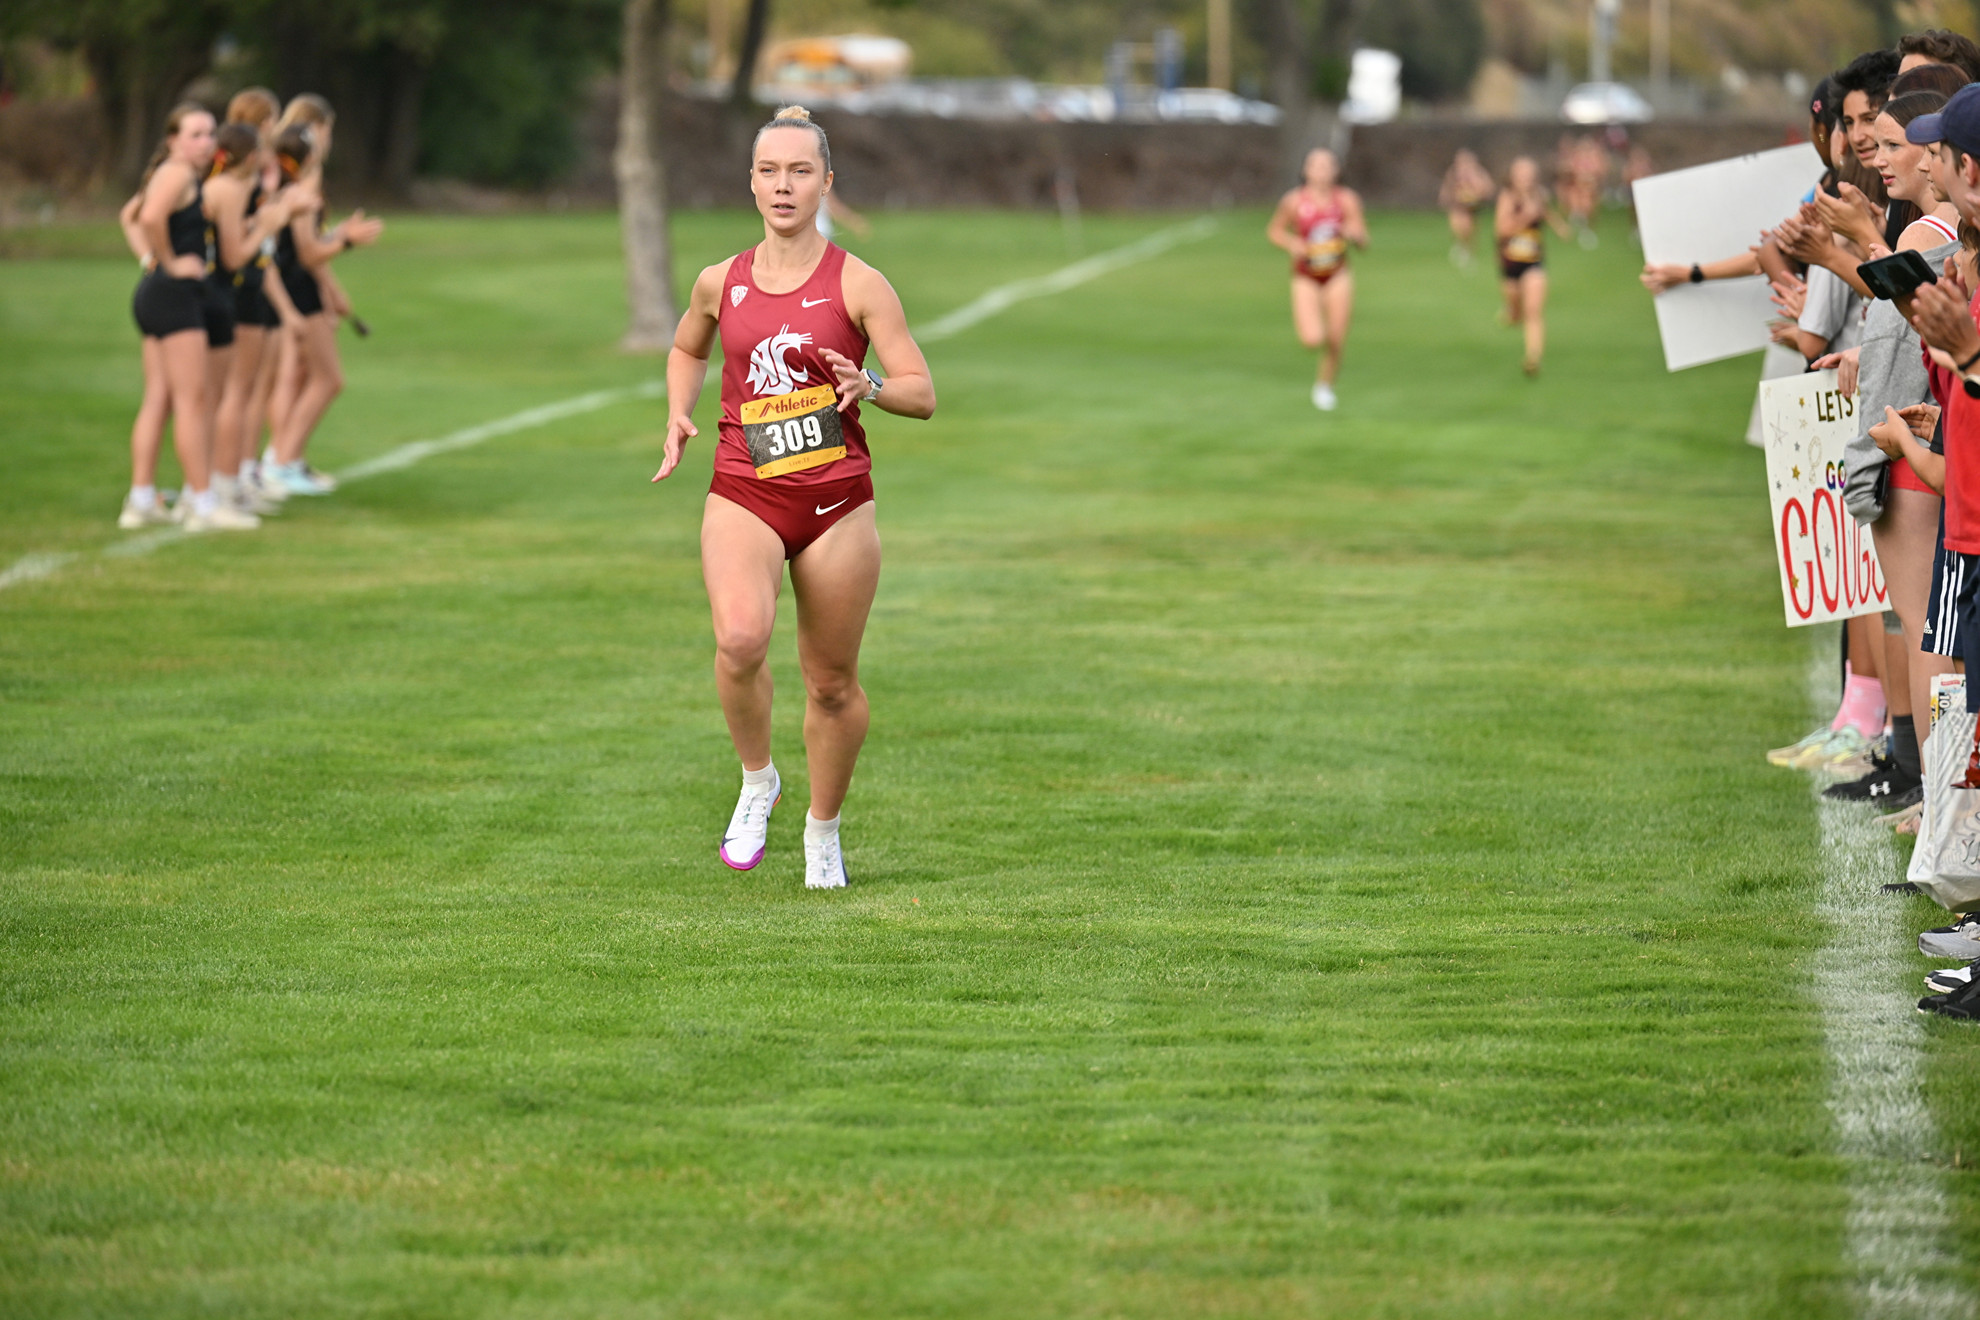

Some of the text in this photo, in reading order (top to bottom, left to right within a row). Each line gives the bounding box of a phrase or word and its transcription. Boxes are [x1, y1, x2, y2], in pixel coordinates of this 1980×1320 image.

[759, 397, 818, 418] Athletic
[1816, 389, 1853, 422] LETS
[765, 416, 823, 456] 309
[1826, 459, 1846, 490] GO
